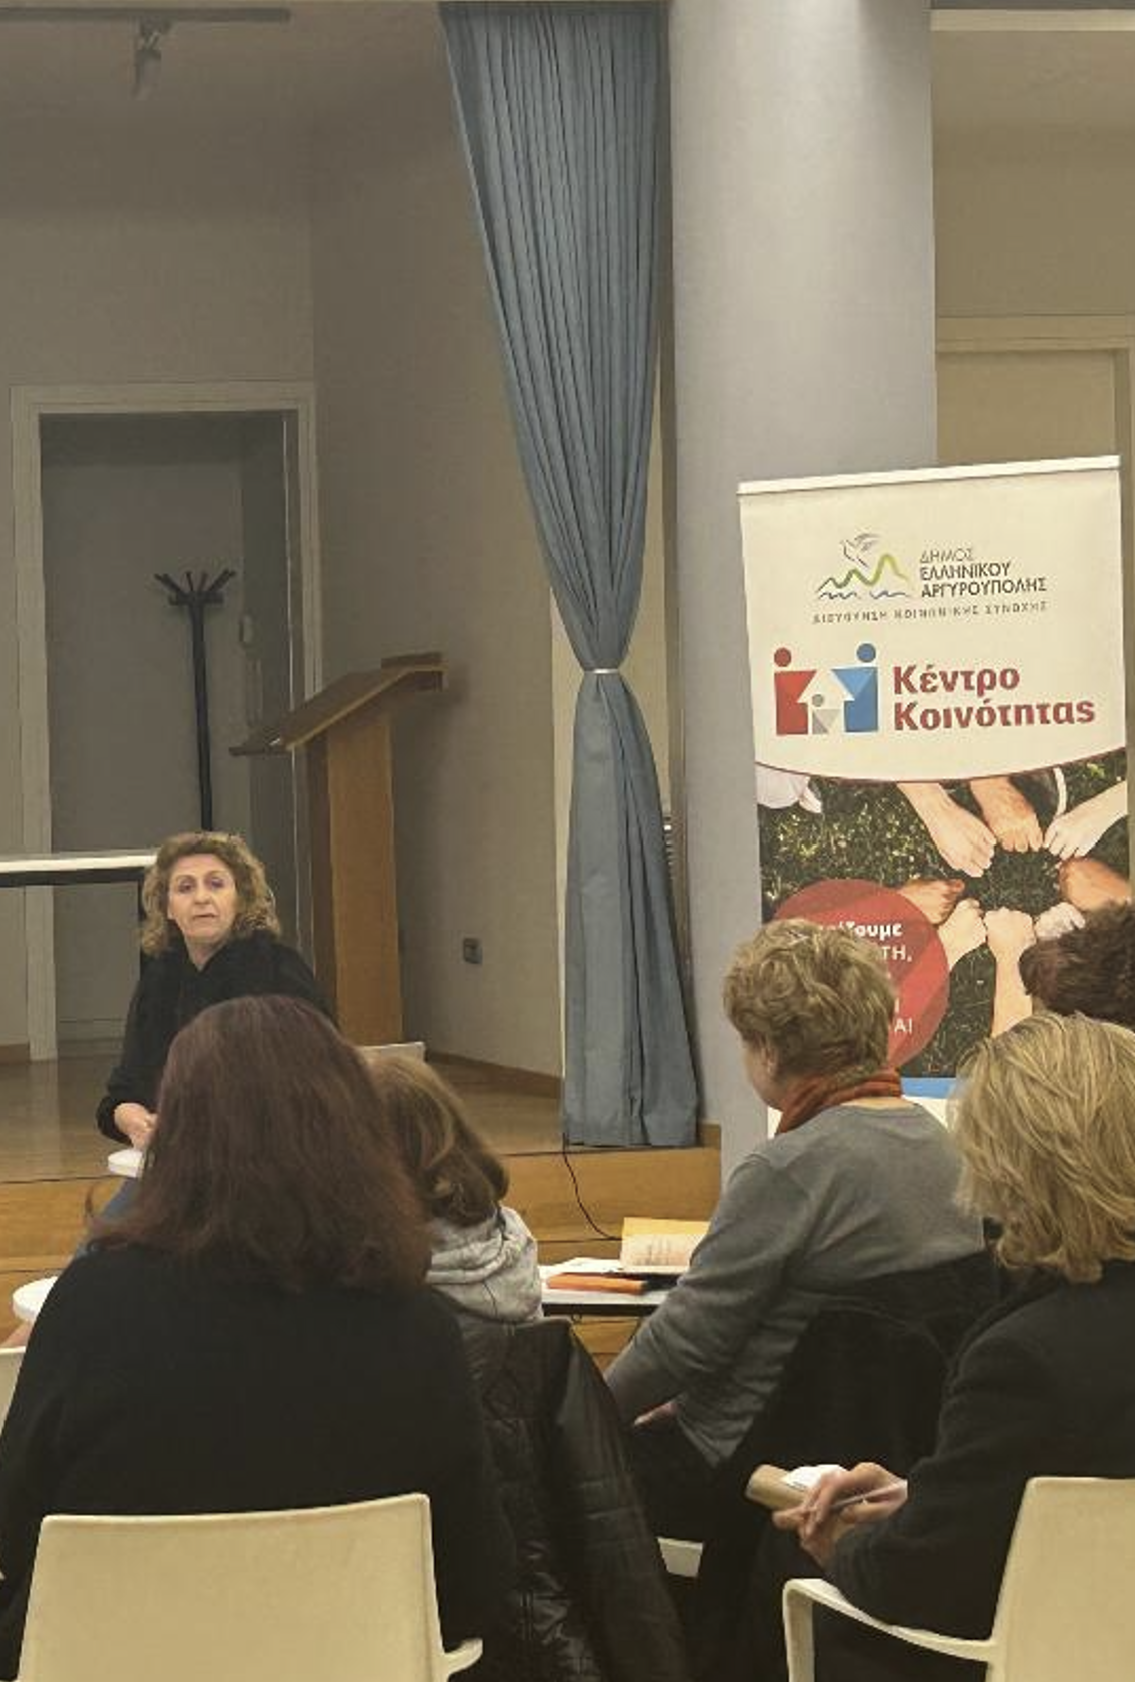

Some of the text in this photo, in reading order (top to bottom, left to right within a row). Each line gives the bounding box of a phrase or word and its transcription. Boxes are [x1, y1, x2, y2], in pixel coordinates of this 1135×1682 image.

[918, 547, 975, 564] ΔΗΜΟΣ
[920, 561, 1012, 581] ΕΛΛΗΝΙΚΟΥ
[921, 577, 1048, 599] ΑΡΓΥΡΟΥΠΟΛΗΣ
[893, 664, 1021, 698] Κέντρο
[893, 693, 1096, 733] Κοινότητας
